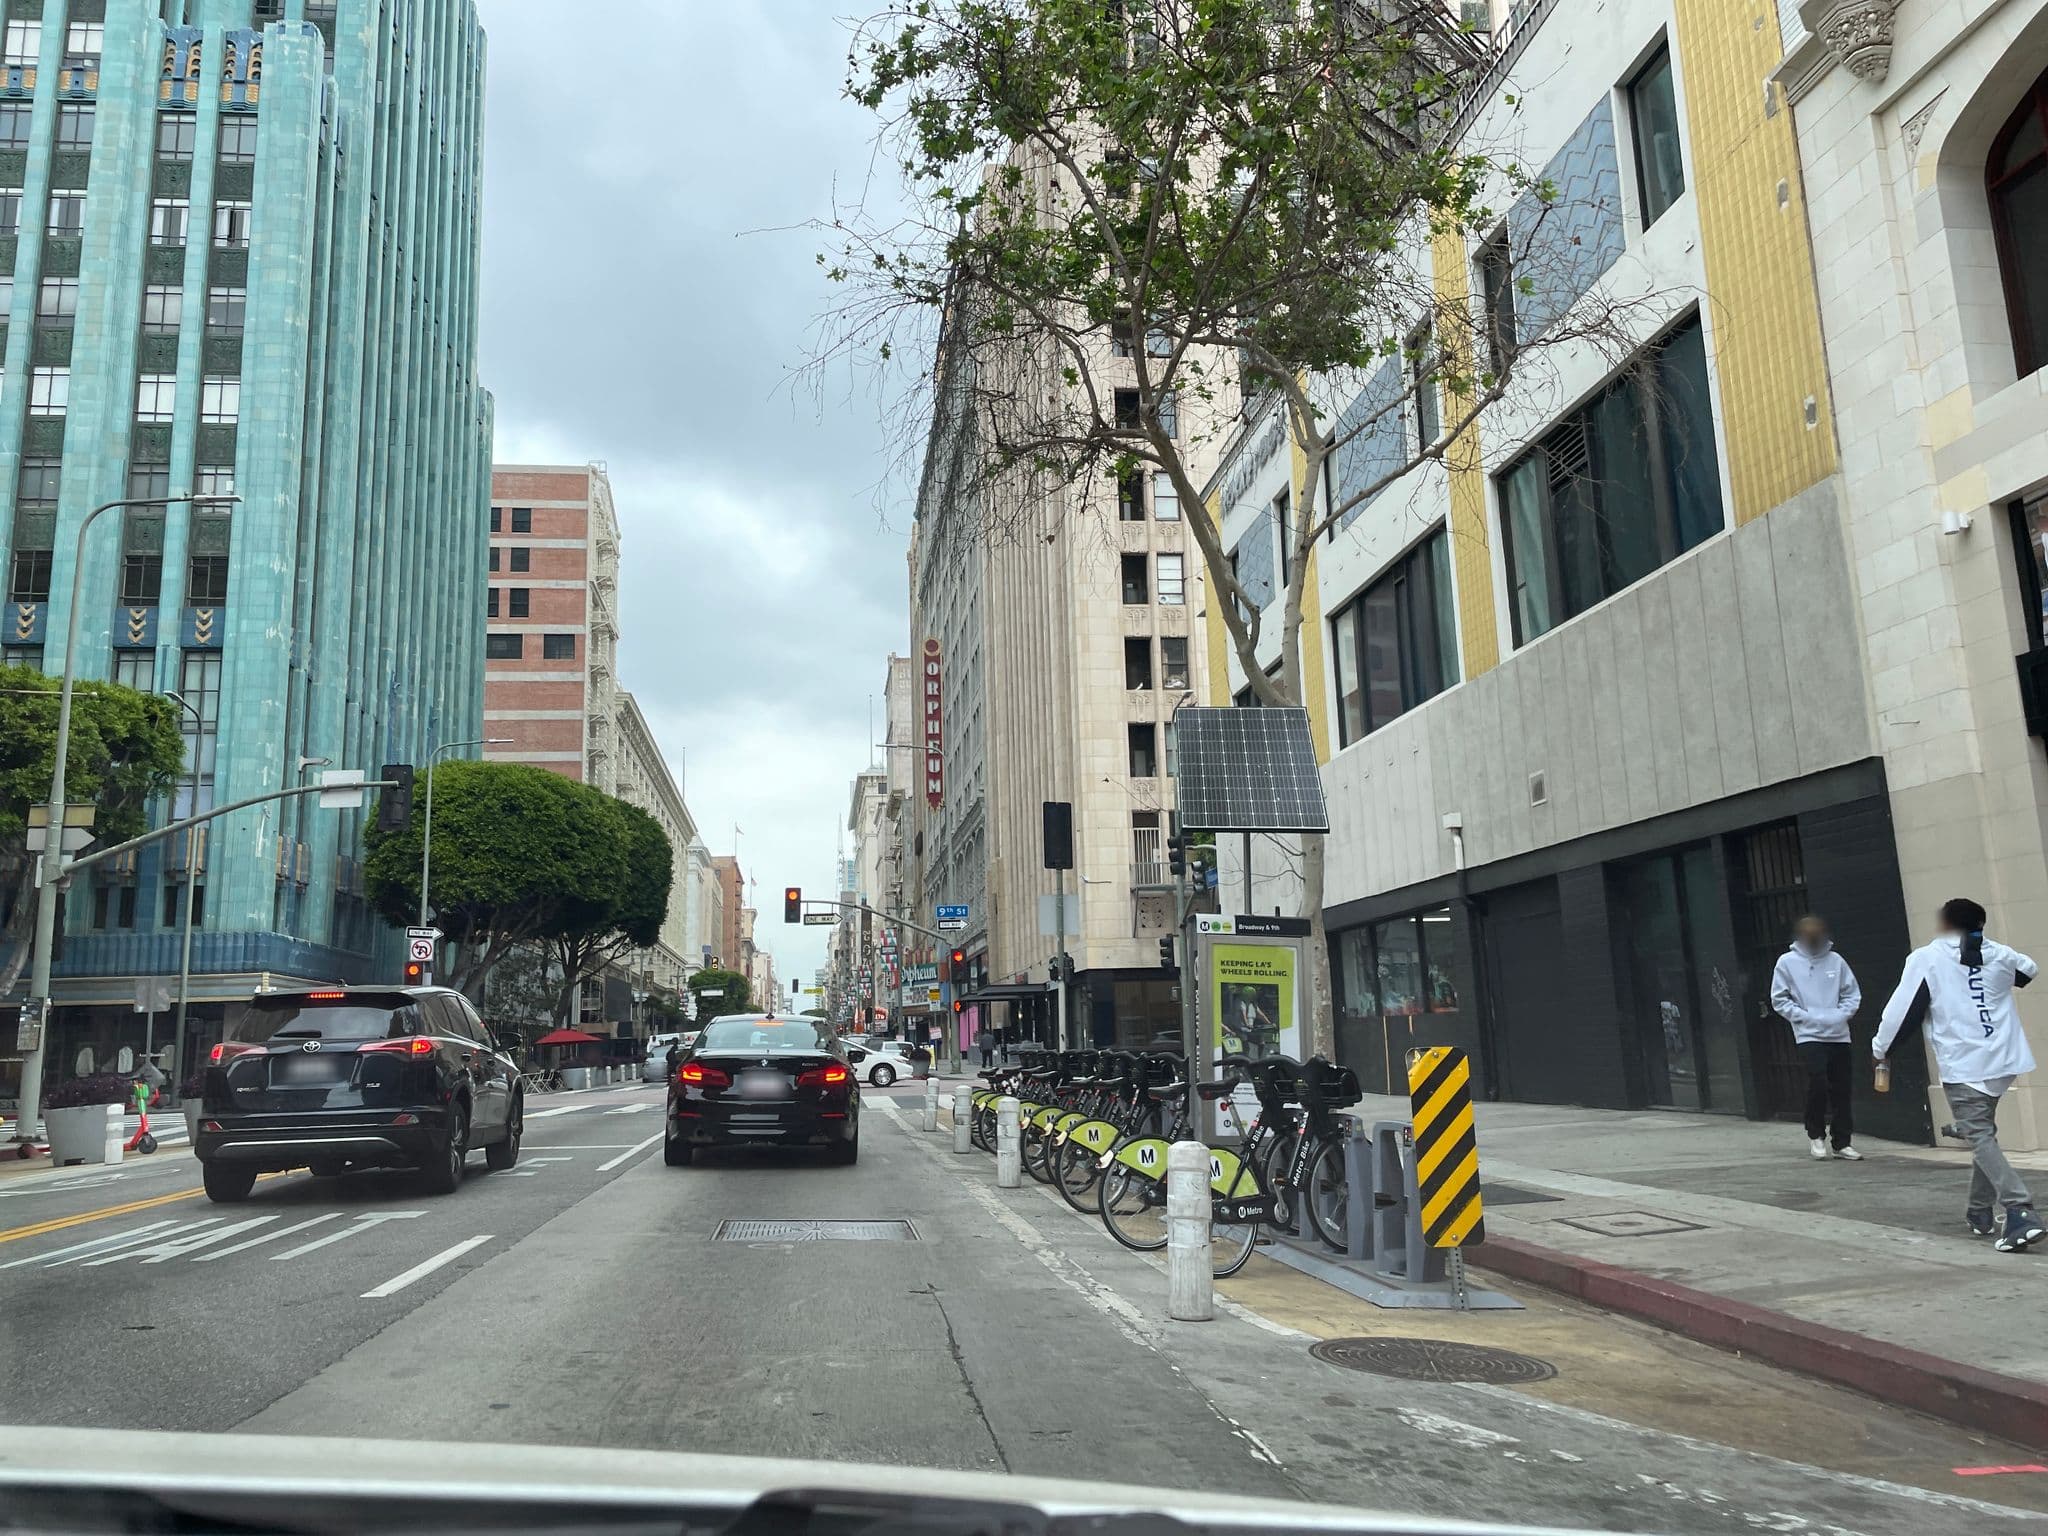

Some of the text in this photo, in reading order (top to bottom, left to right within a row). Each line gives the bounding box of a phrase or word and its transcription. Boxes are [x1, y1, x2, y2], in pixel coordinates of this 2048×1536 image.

[926, 661, 941, 794] ORPHEUM
[939, 907, 966, 916] 9th St
[1238, 923, 1265, 931] Broadway
[1220, 960, 1254, 968] KEEPING
[1220, 968, 1252, 976] WHEELS
[1967, 965, 1994, 1039] AUTICA
[1088, 1129, 1099, 1142] M
[1252, 1125, 1265, 1143] Bike
[1141, 1149, 1154, 1163] M
[1210, 1160, 1221, 1178] M
[1292, 1160, 1305, 1187] Metro
[1300, 1140, 1311, 1160] Bike
[1246, 1207, 1263, 1216] Metro
